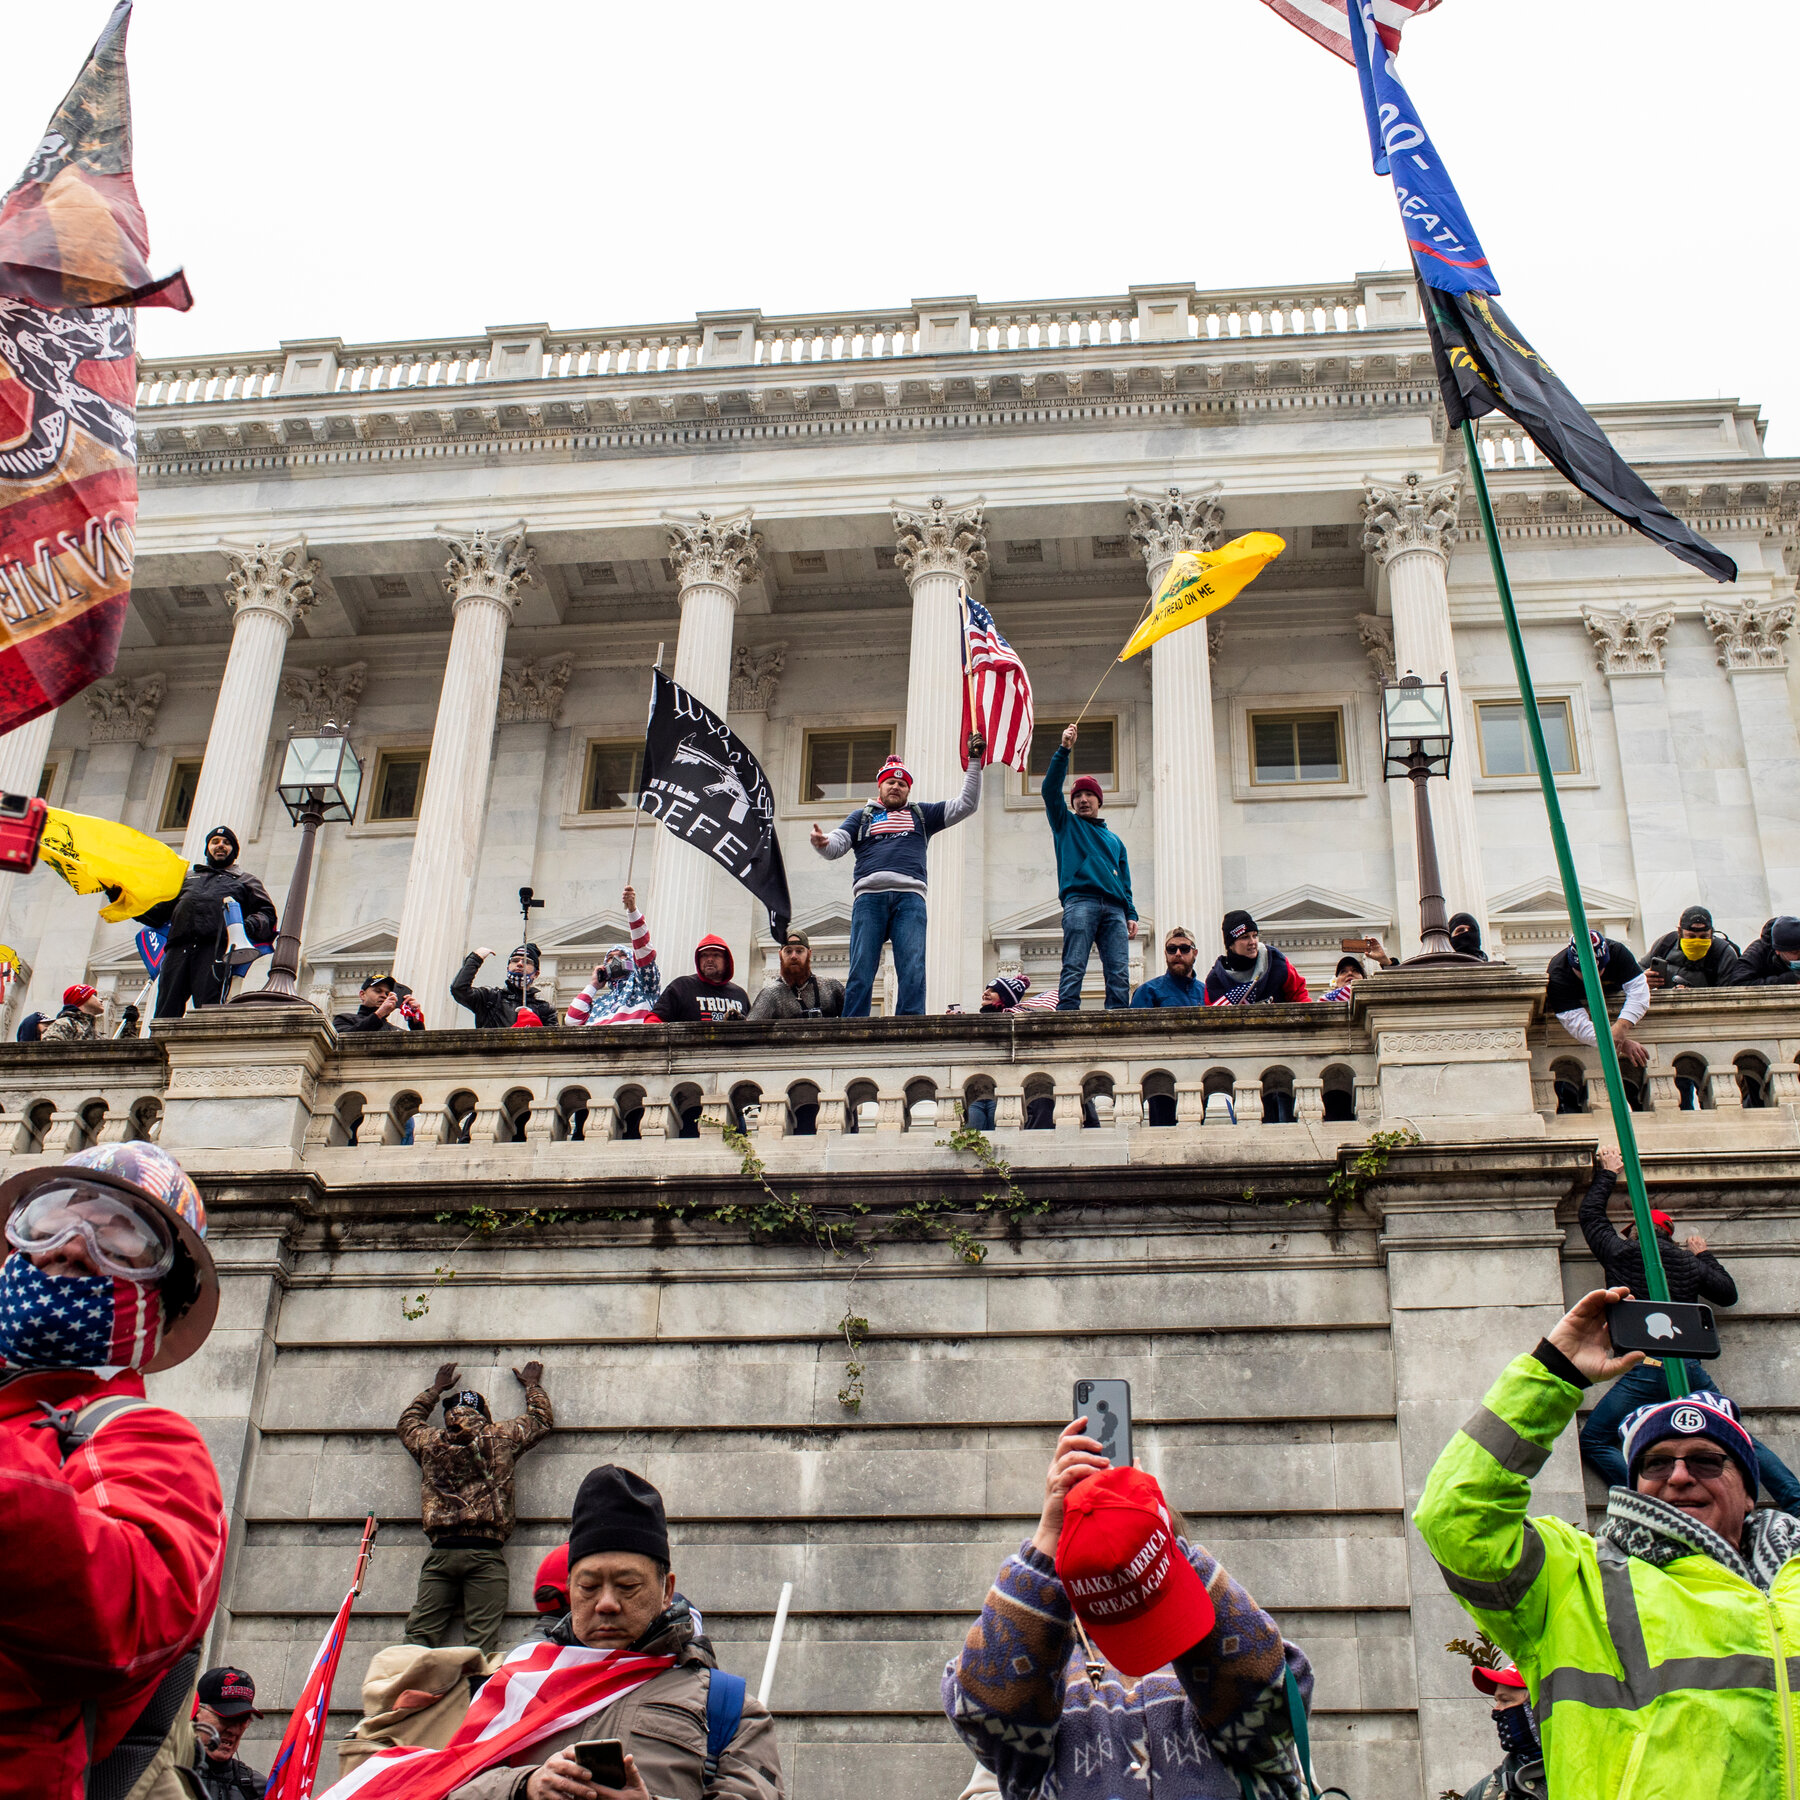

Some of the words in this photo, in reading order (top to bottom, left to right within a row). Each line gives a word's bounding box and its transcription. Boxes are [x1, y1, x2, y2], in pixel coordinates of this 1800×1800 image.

[1184, 592, 1199, 606] ON
[1197, 583, 1216, 599] ME
[639, 790, 753, 878] DEFE
[696, 996, 743, 1013] TRUMP
[1677, 1412, 1699, 1427] 45
[1069, 1575, 1117, 1597] MAKE
[1116, 1529, 1167, 1586] AMERICA
[1088, 1589, 1142, 1616] GREAT
[1140, 1552, 1171, 1599] AGAIN
